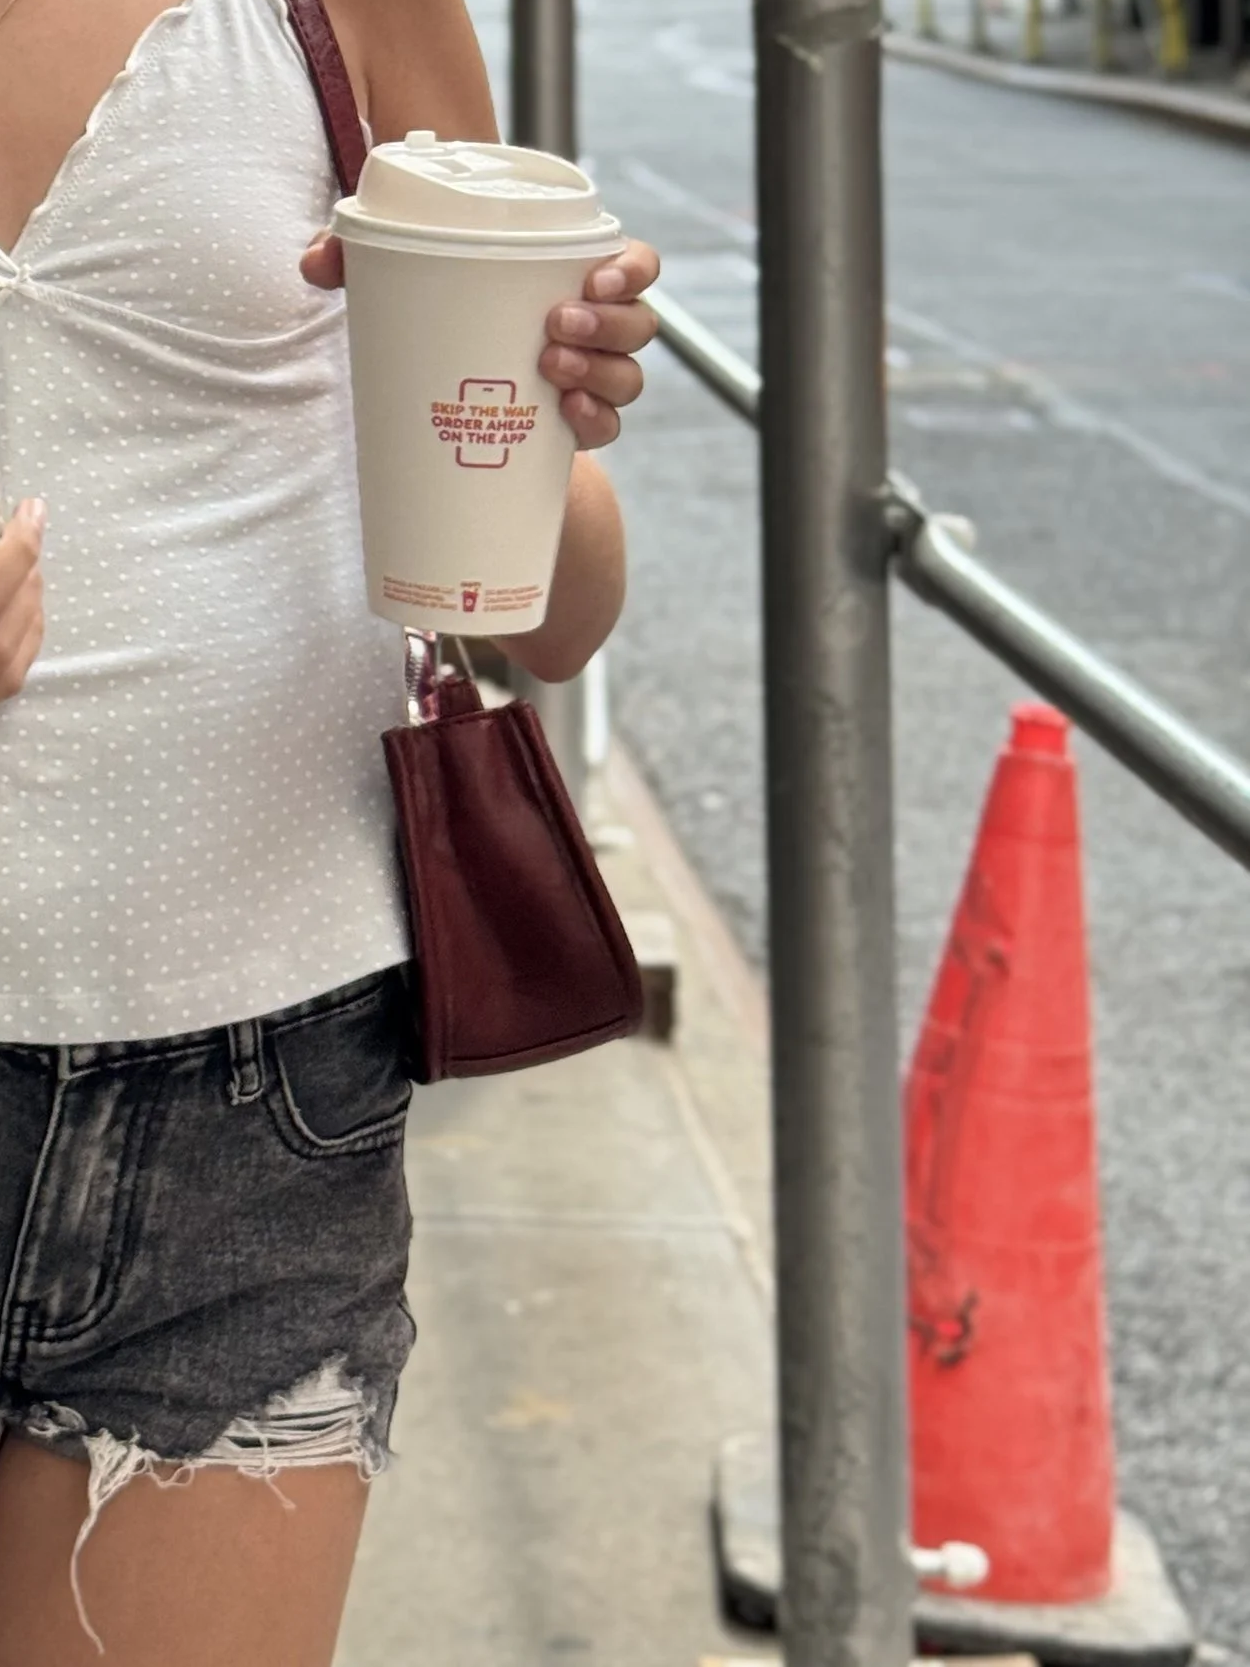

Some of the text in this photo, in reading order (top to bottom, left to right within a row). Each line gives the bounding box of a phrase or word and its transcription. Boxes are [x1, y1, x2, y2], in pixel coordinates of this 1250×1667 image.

[431, 401, 539, 417] SKIP THE WAIT
[431, 416, 535, 431] ORDER AHEAD
[439, 430, 527, 445] ON THE APP
